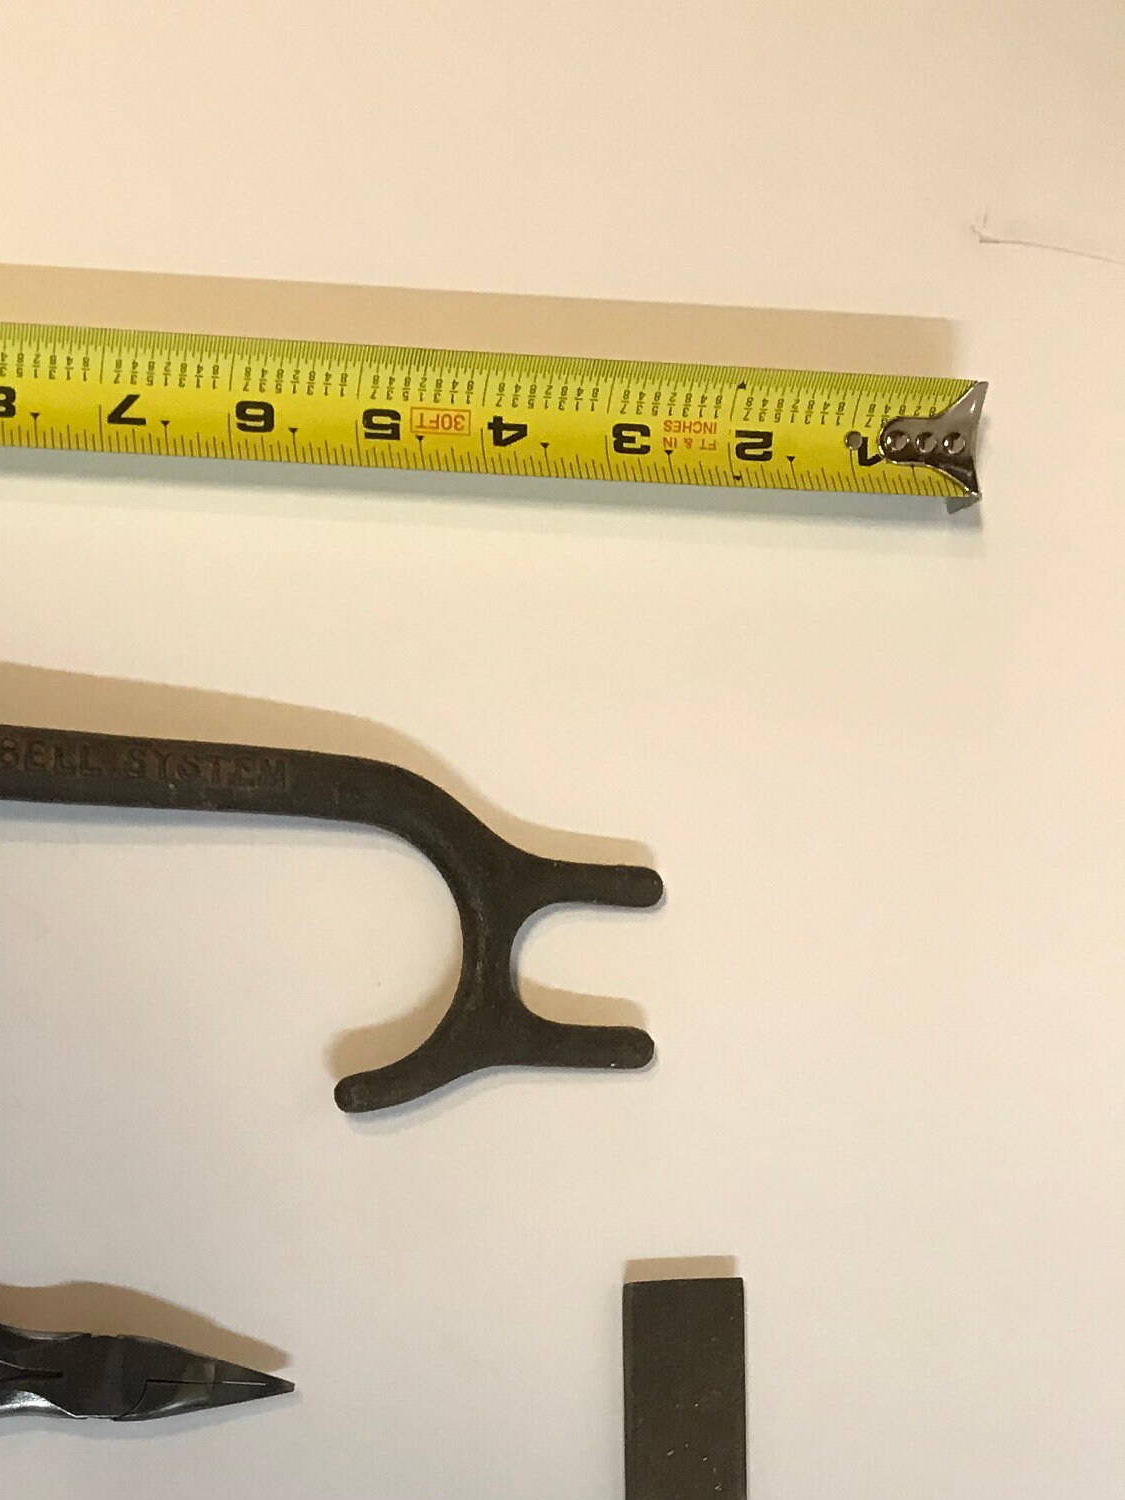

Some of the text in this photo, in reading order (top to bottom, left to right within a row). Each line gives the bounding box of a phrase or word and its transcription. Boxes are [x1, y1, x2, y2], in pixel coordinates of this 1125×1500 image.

[108, 395, 146, 425] 7
[236, 401, 274, 432] 6
[363, 409, 400, 440] 5
[415, 413, 464, 431] 30FT
[488, 416, 527, 446] 4
[613, 424, 650, 454] 3
[664, 421, 716, 433] INCHES
[663, 437, 716, 450] FT & IN
[736, 431, 772, 461] 2
[857, 436, 882, 466] 1
[122, 744, 288, 790] SYSTEM
